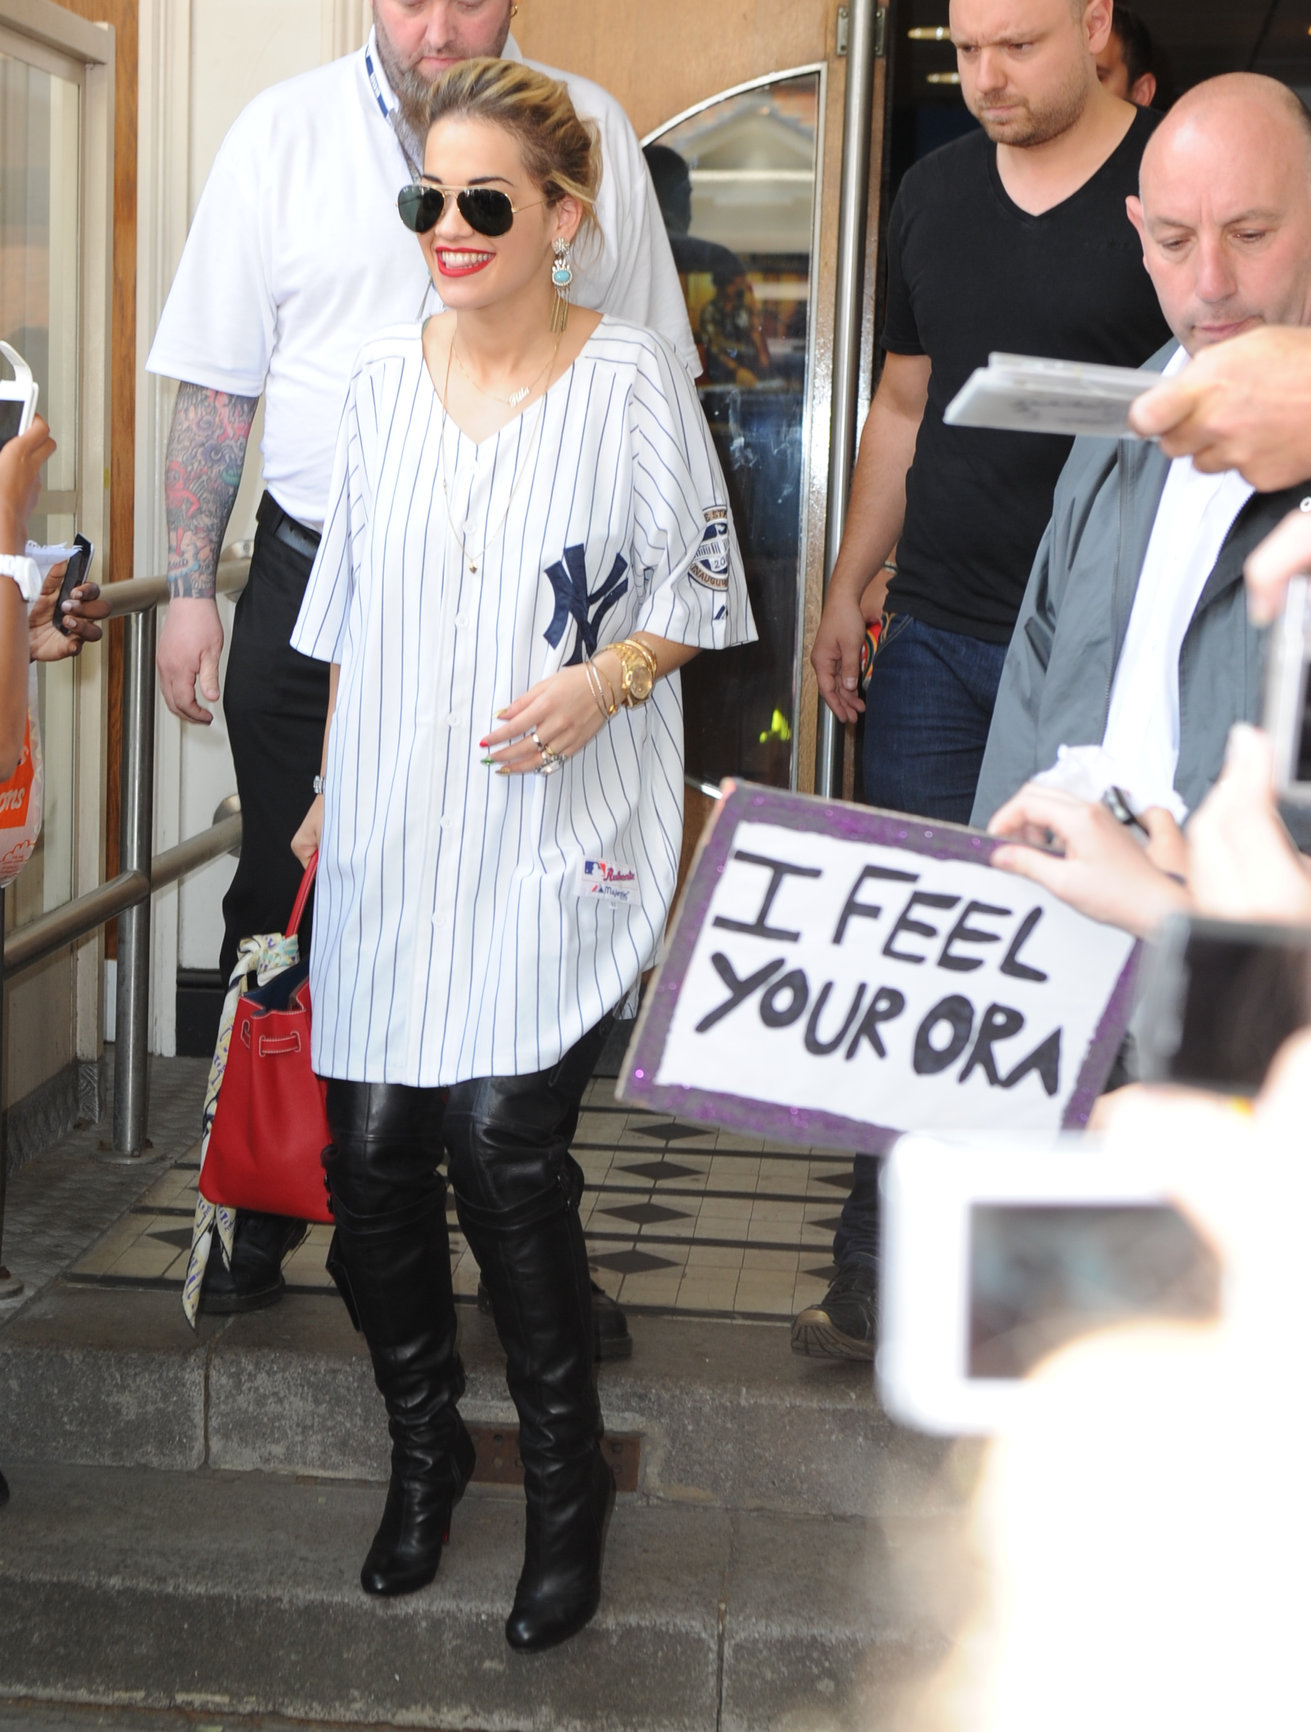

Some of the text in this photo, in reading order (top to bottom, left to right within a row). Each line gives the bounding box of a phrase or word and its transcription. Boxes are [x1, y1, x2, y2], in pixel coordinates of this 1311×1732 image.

[712, 849, 1048, 983] I FEEL
[695, 952, 1062, 1097] YOUR ORA
